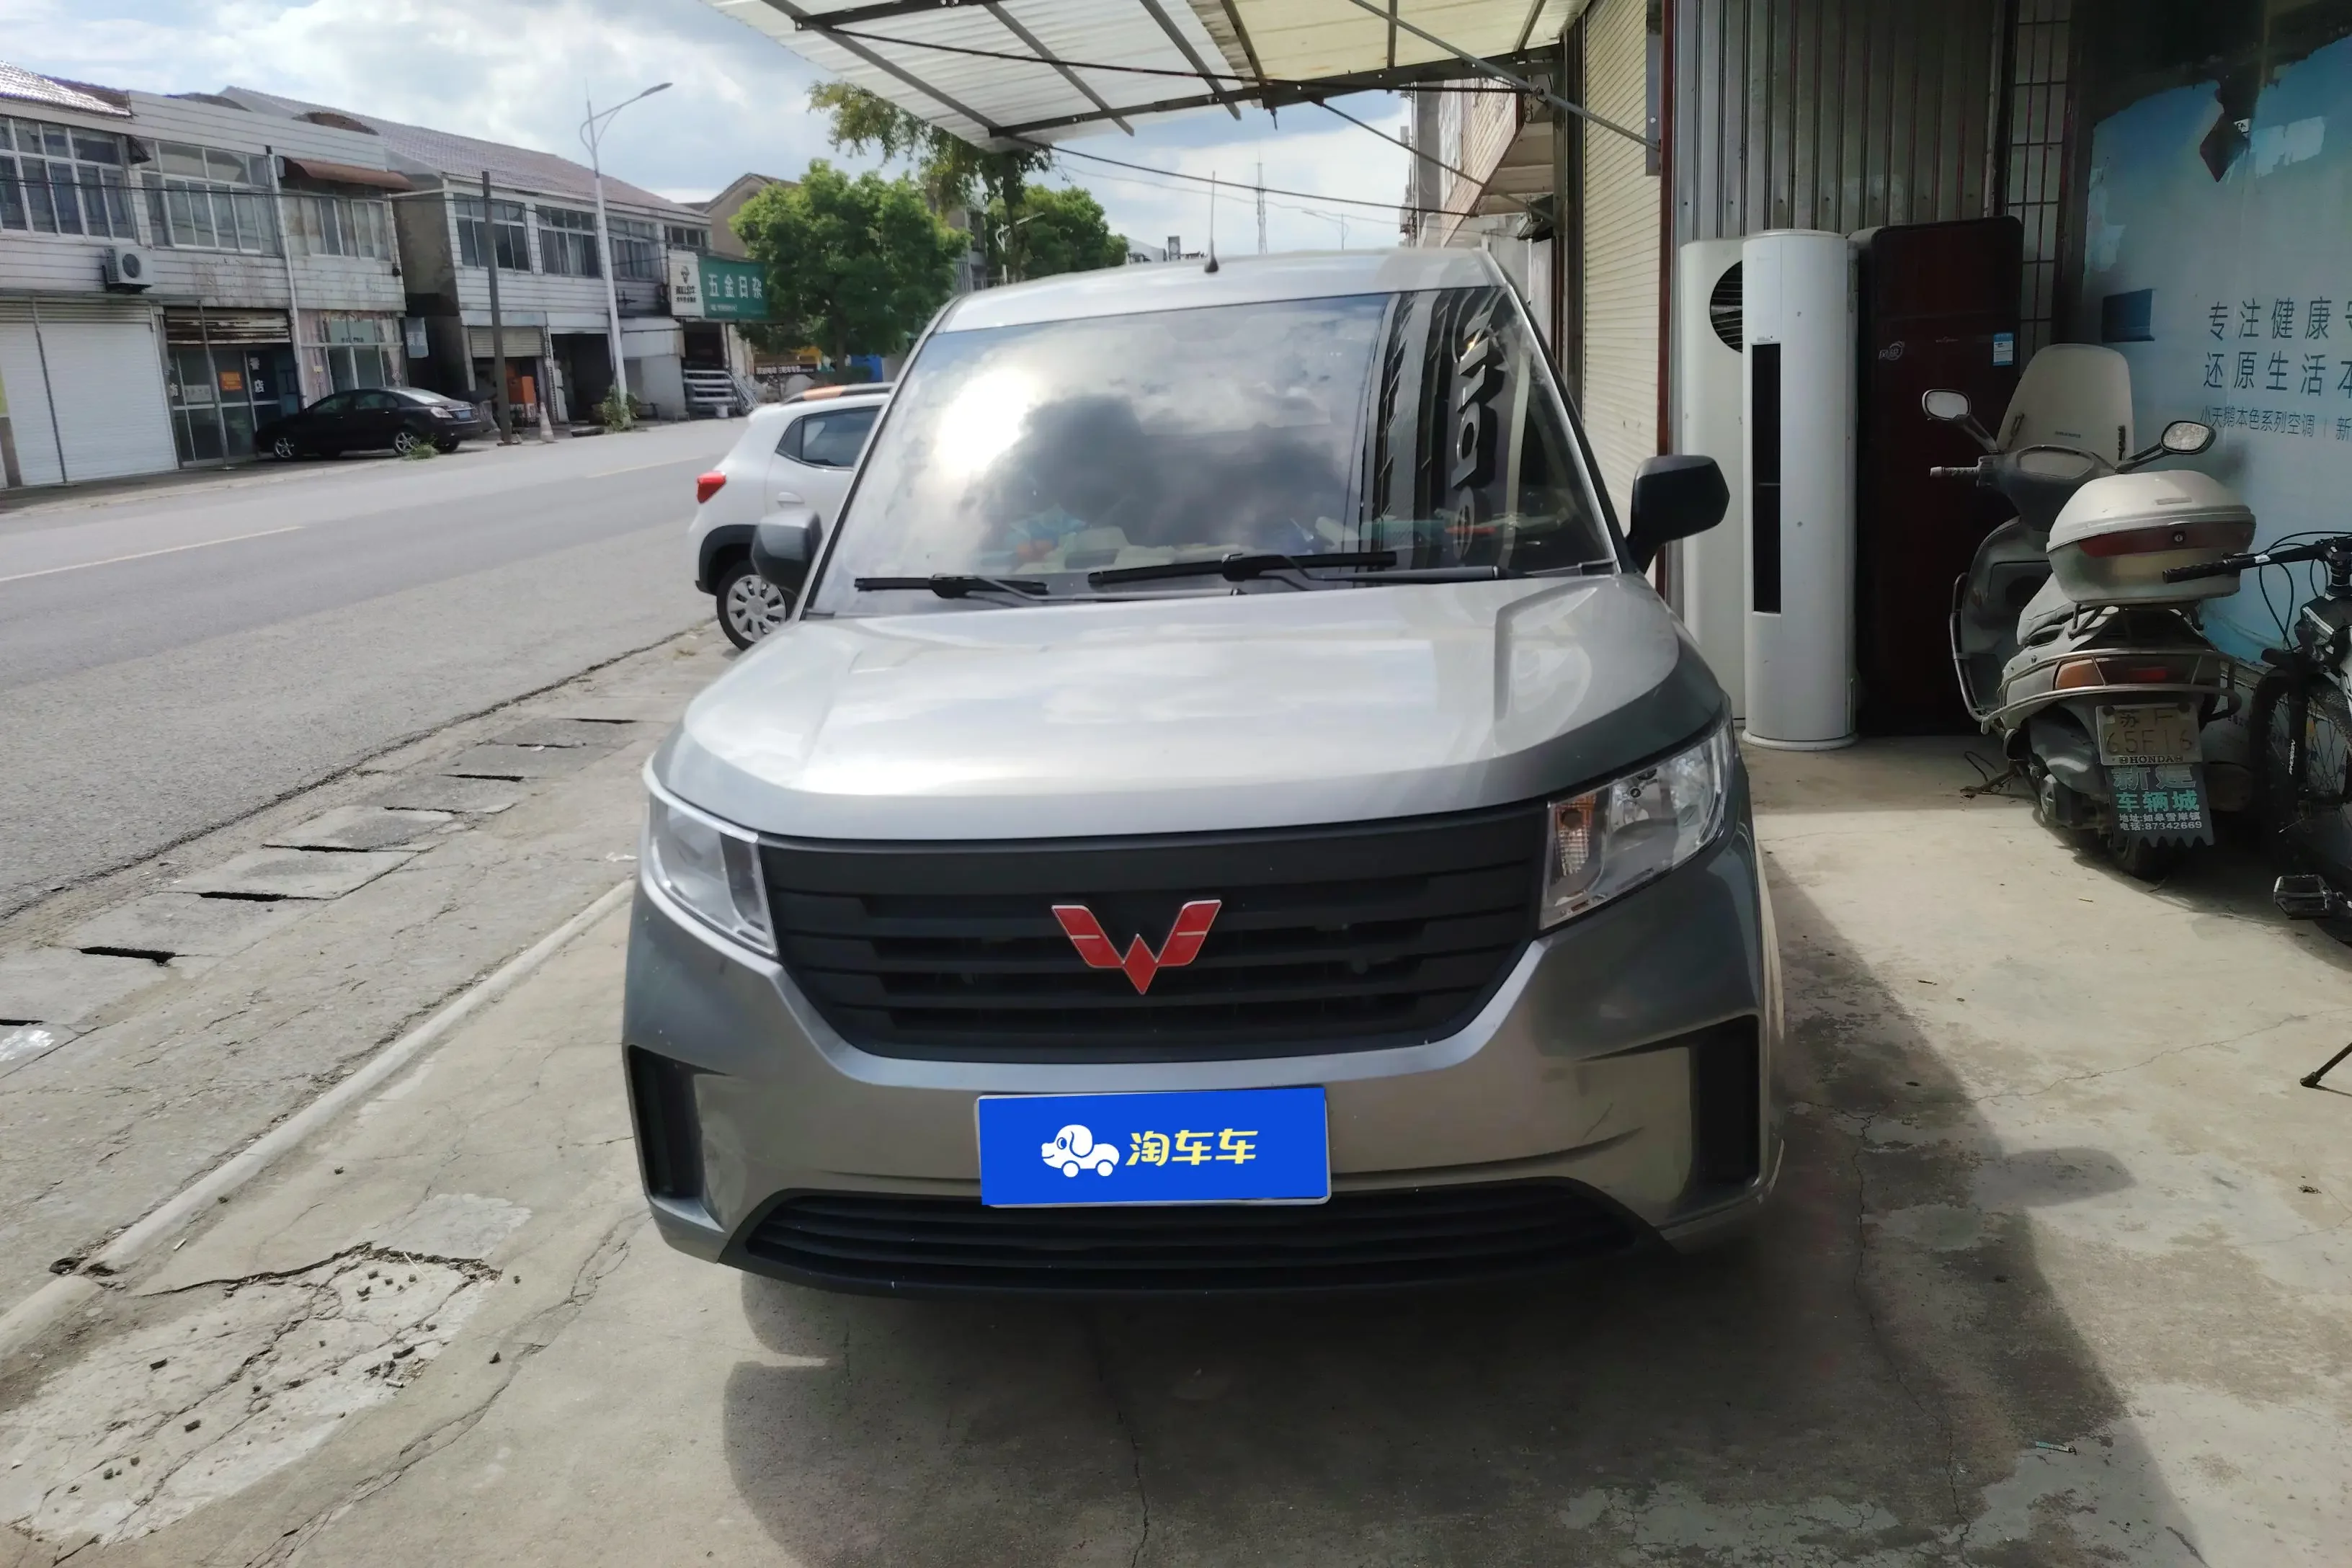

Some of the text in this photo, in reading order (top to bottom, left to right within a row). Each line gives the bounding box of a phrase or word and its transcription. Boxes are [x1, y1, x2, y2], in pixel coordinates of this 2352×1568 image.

[708, 273, 763, 299] 五金日杂
[2200, 406, 2315, 437] 小天鹅本色系列空调
[2130, 755, 2175, 764] HONDA
[2116, 790, 2199, 813] 车辆城
